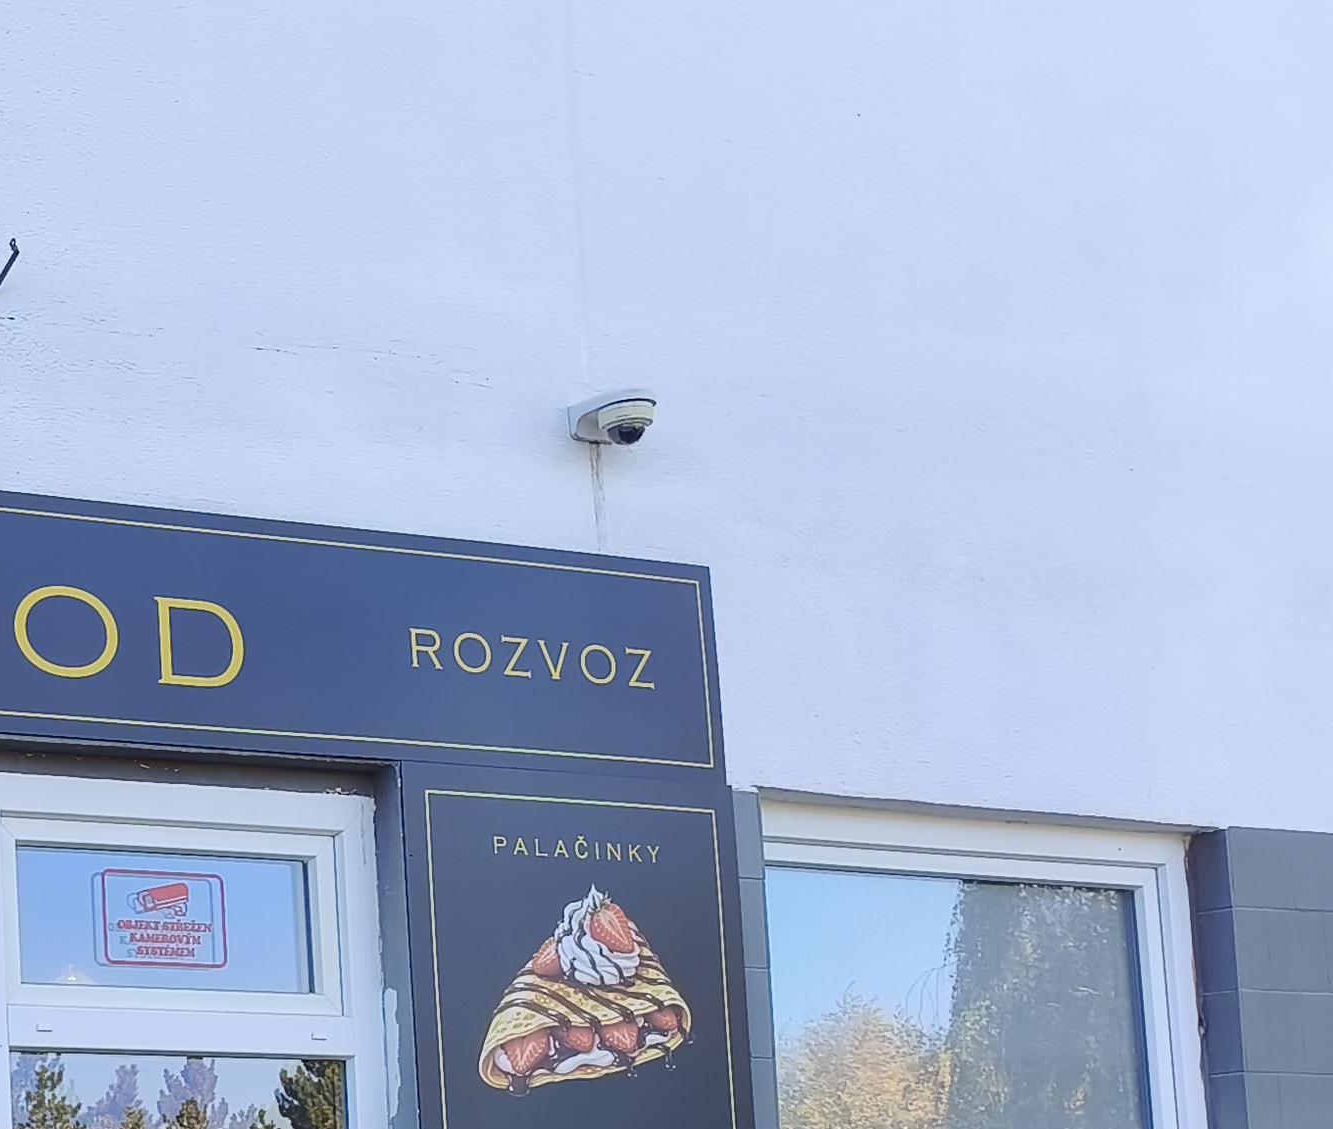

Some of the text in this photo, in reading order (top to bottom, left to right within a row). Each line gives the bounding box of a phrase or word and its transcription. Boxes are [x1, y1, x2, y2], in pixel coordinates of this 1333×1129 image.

[408, 627, 656, 690] ROZVOZ
[493, 835, 660, 864] PALAČINKY
[117, 918, 212, 933] OBJEKT STŘEŽEN
[129, 931, 201, 946] KAMEROVÝM
[136, 944, 195, 958] SYSTÉMEM
